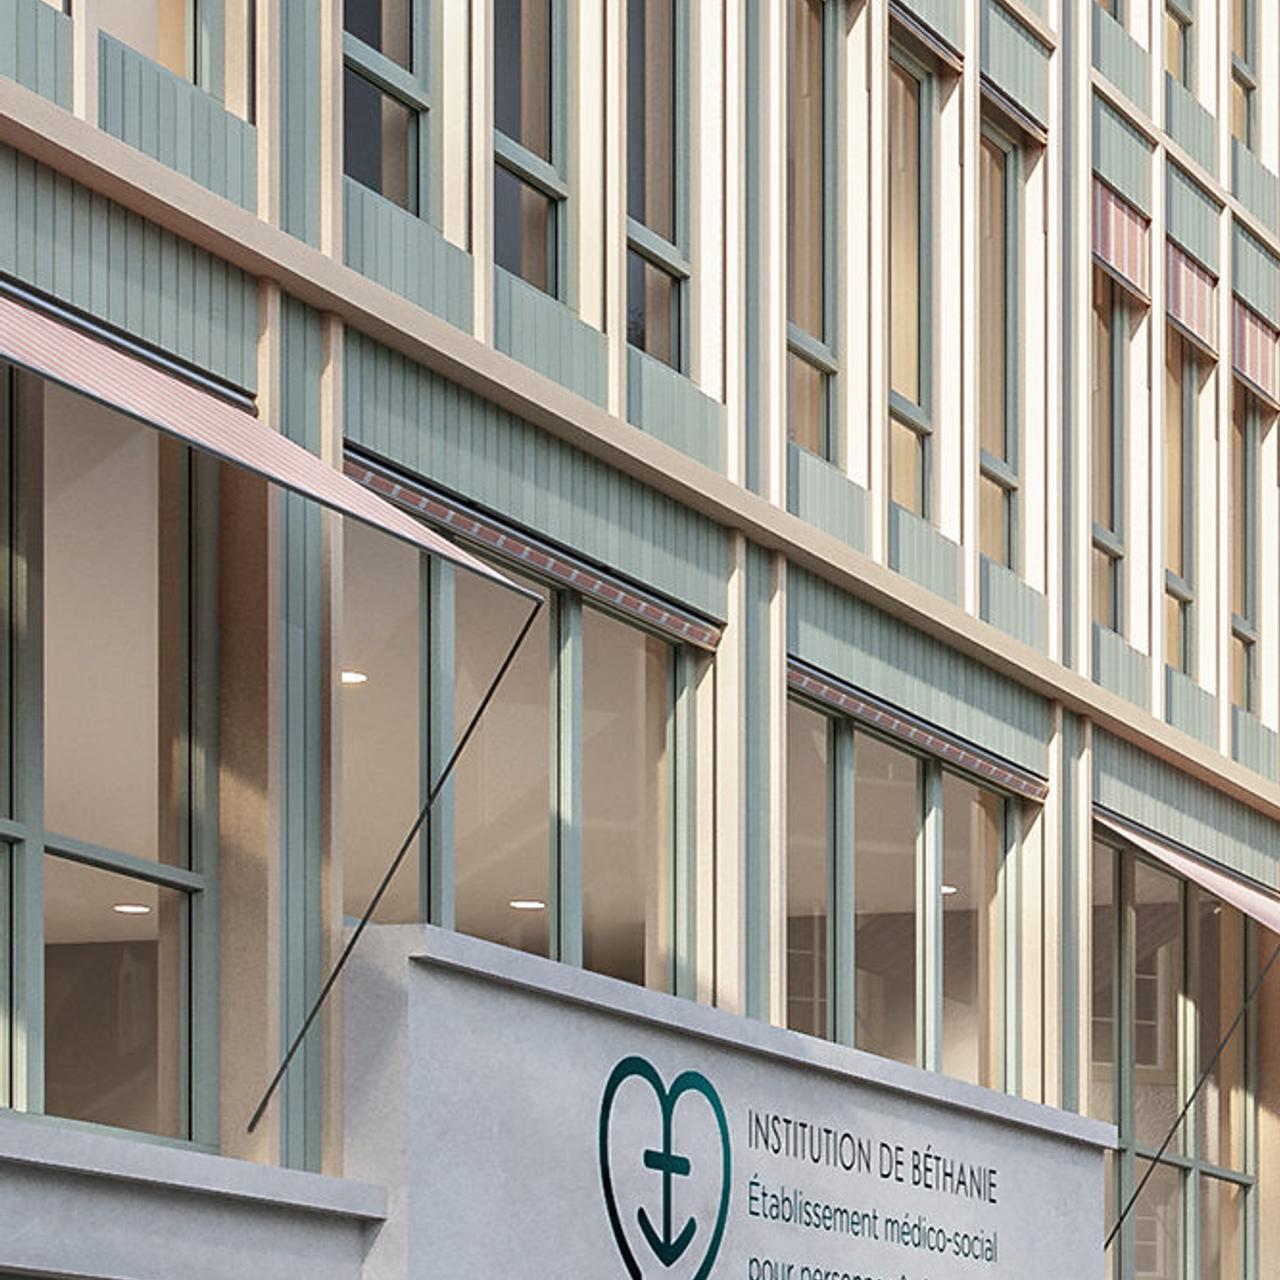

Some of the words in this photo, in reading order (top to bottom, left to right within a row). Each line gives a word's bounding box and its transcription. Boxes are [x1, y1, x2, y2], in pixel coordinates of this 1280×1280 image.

[748, 1109, 871, 1174] INSTITUTION
[879, 1141, 904, 1183] DE
[911, 1144, 998, 1204] BÉTHANIE
[748, 1172, 879, 1241] Établissement
[884, 1212, 998, 1263] médico-social
